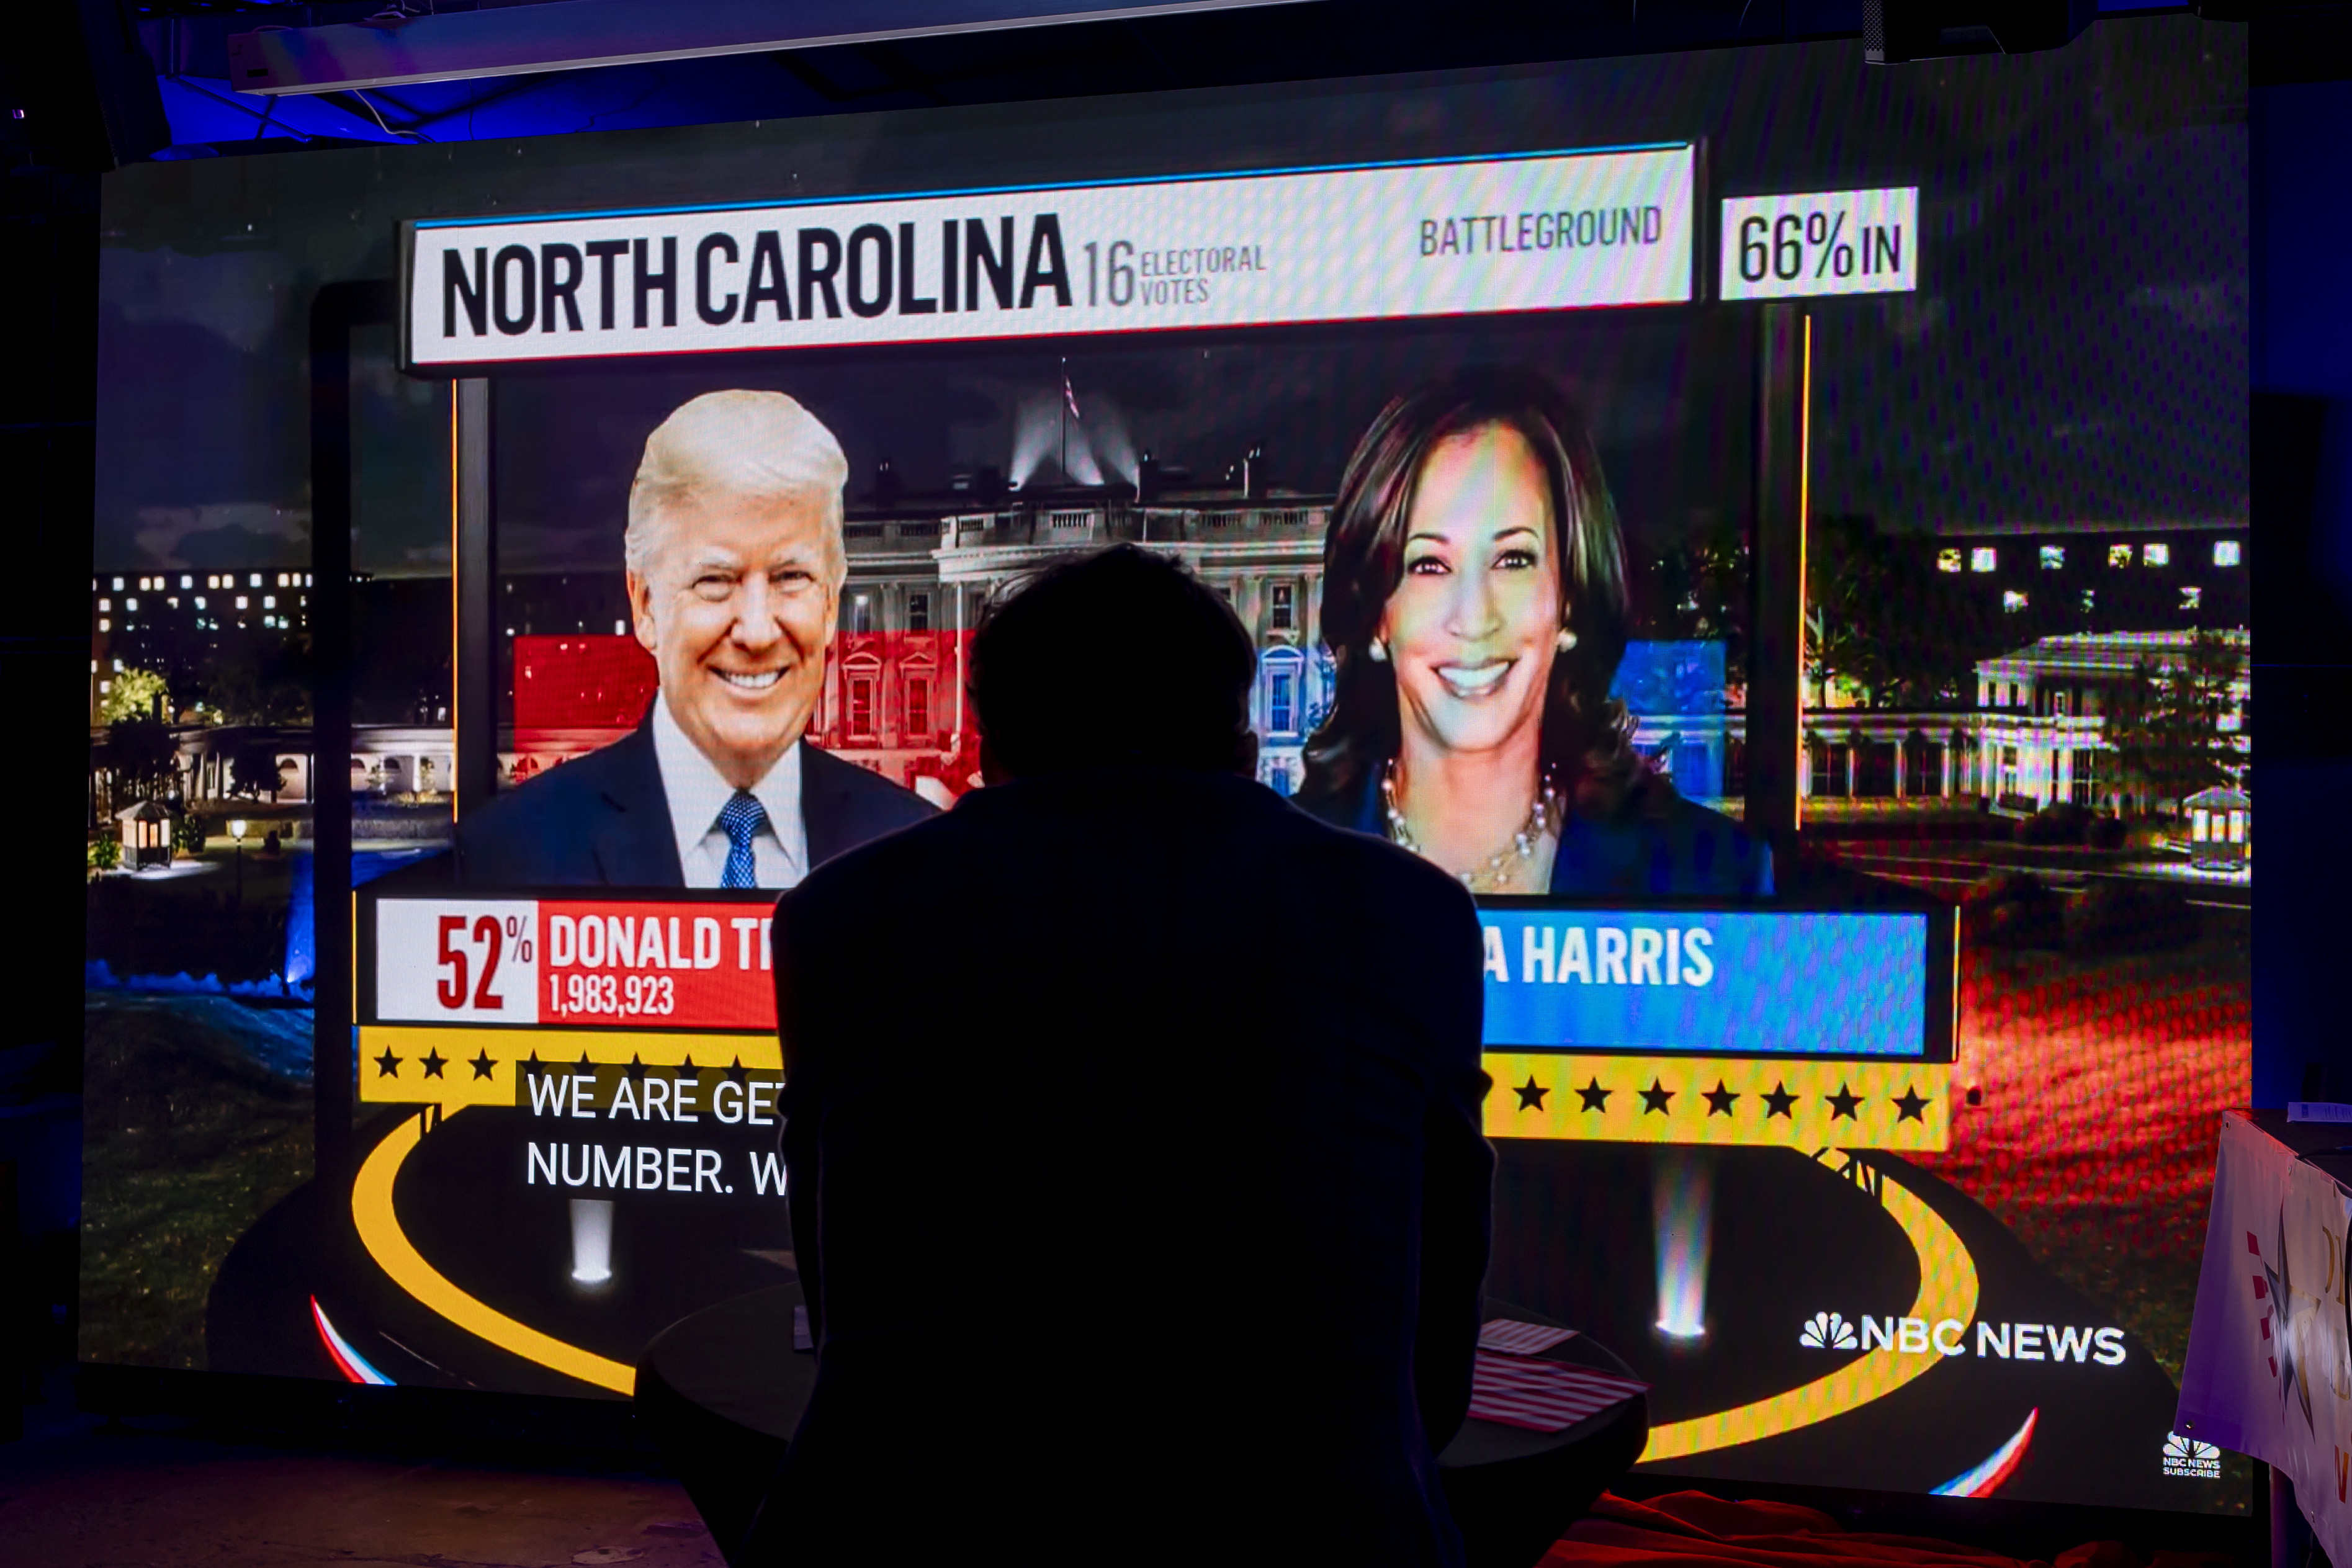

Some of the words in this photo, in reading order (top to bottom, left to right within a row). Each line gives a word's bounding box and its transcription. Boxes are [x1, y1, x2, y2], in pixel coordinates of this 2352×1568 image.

[1419, 206, 1662, 257] BATTLEGROUND
[1739, 209, 1855, 283] 66%
[1861, 225, 1902, 276] IN
[442, 235, 678, 338] NORTH
[694, 212, 1073, 326] CAROLINA
[1083, 240, 1135, 307] 16
[1141, 245, 1267, 277] ELECTORAL
[1141, 278, 1209, 307] VOTES
[436, 915, 532, 1011] 52%
[549, 915, 721, 970] DONALD
[1522, 925, 1715, 988] HARRIS
[549, 974, 675, 1018] 1,983,923
[527, 1073, 597, 1119] WE
[608, 1077, 699, 1123] ARE
[527, 1142, 734, 1194] NUMBER.
[1861, 1314, 1967, 1356] NBC
[1977, 1320, 2127, 1366] NEWS
[2162, 1467, 2221, 1479] SUBSCRIBE
[2163, 1457, 2187, 1467] NBC
[2188, 1459, 2221, 1470] NEWS
